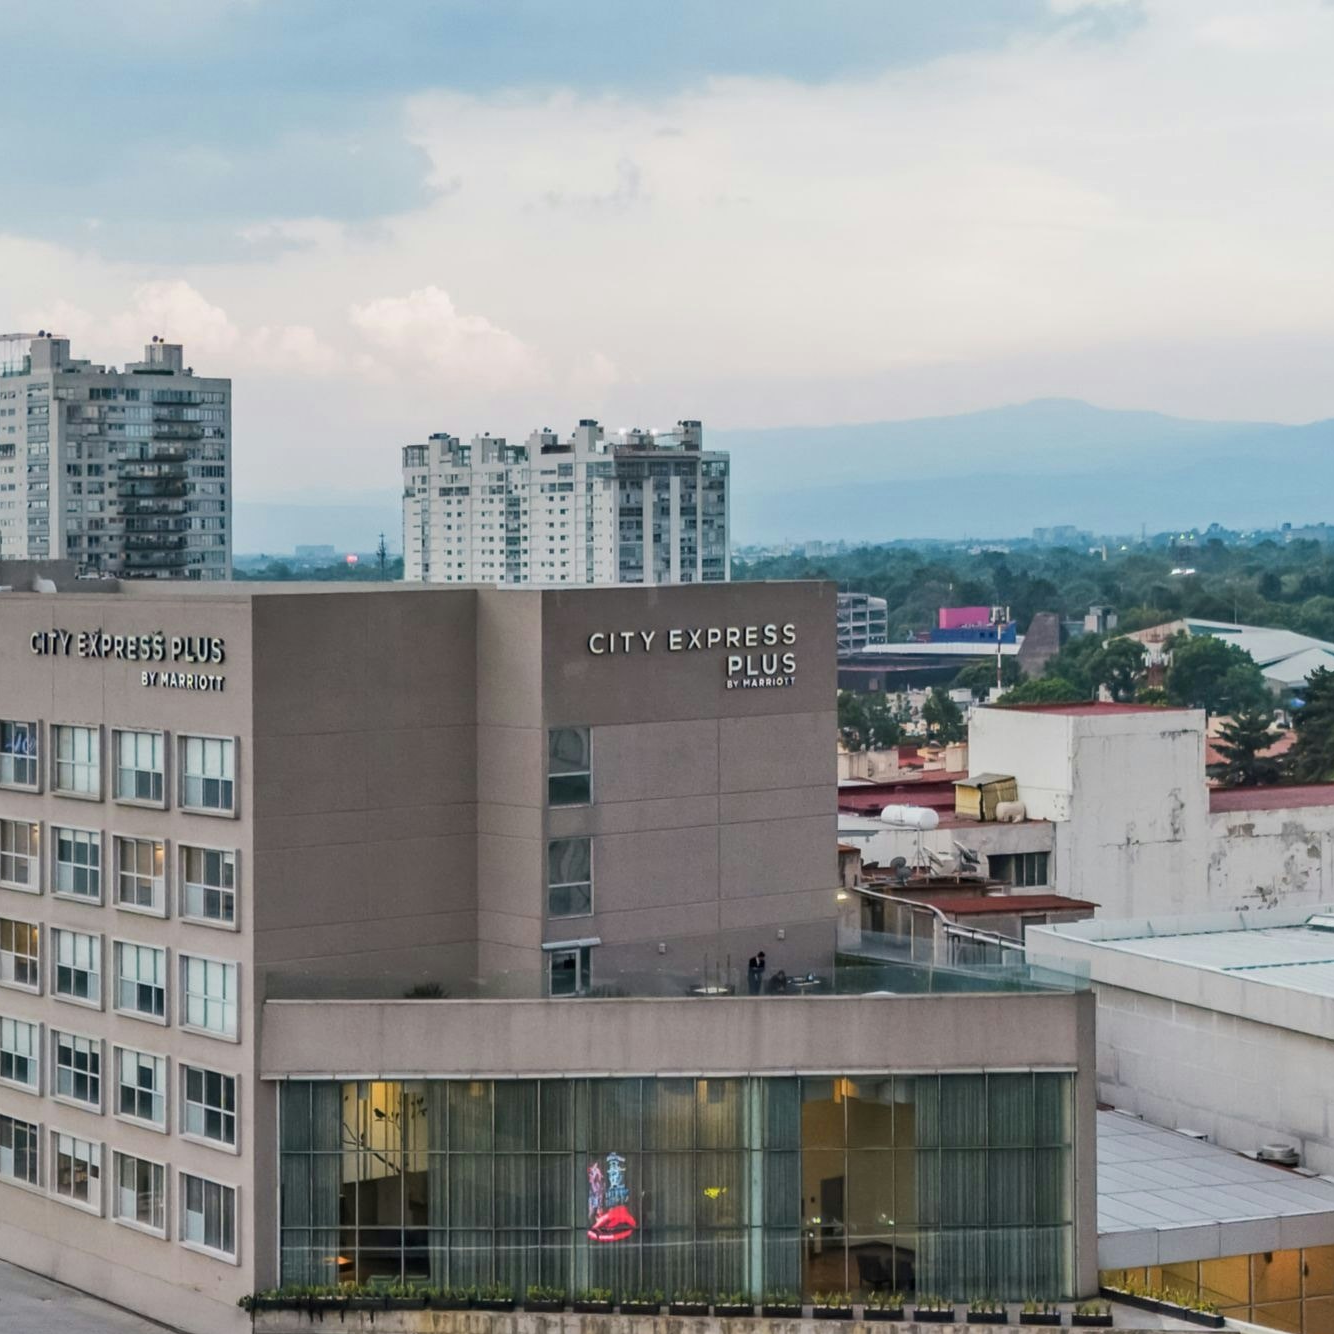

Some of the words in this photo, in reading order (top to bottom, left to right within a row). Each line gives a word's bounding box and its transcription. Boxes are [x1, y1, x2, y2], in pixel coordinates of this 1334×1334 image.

[29, 631, 71, 656] CITY
[77, 633, 165, 661] EXPRESS
[171, 636, 224, 663] PLUS
[589, 631, 655, 654] CITY
[668, 624, 796, 650] EXPRESS
[727, 653, 796, 676] PLUS
[141, 671, 157, 687] BY
[160, 672, 224, 691] MARRIOTT
[727, 679, 739, 689] BY
[743, 677, 796, 688] MARRIOTT
